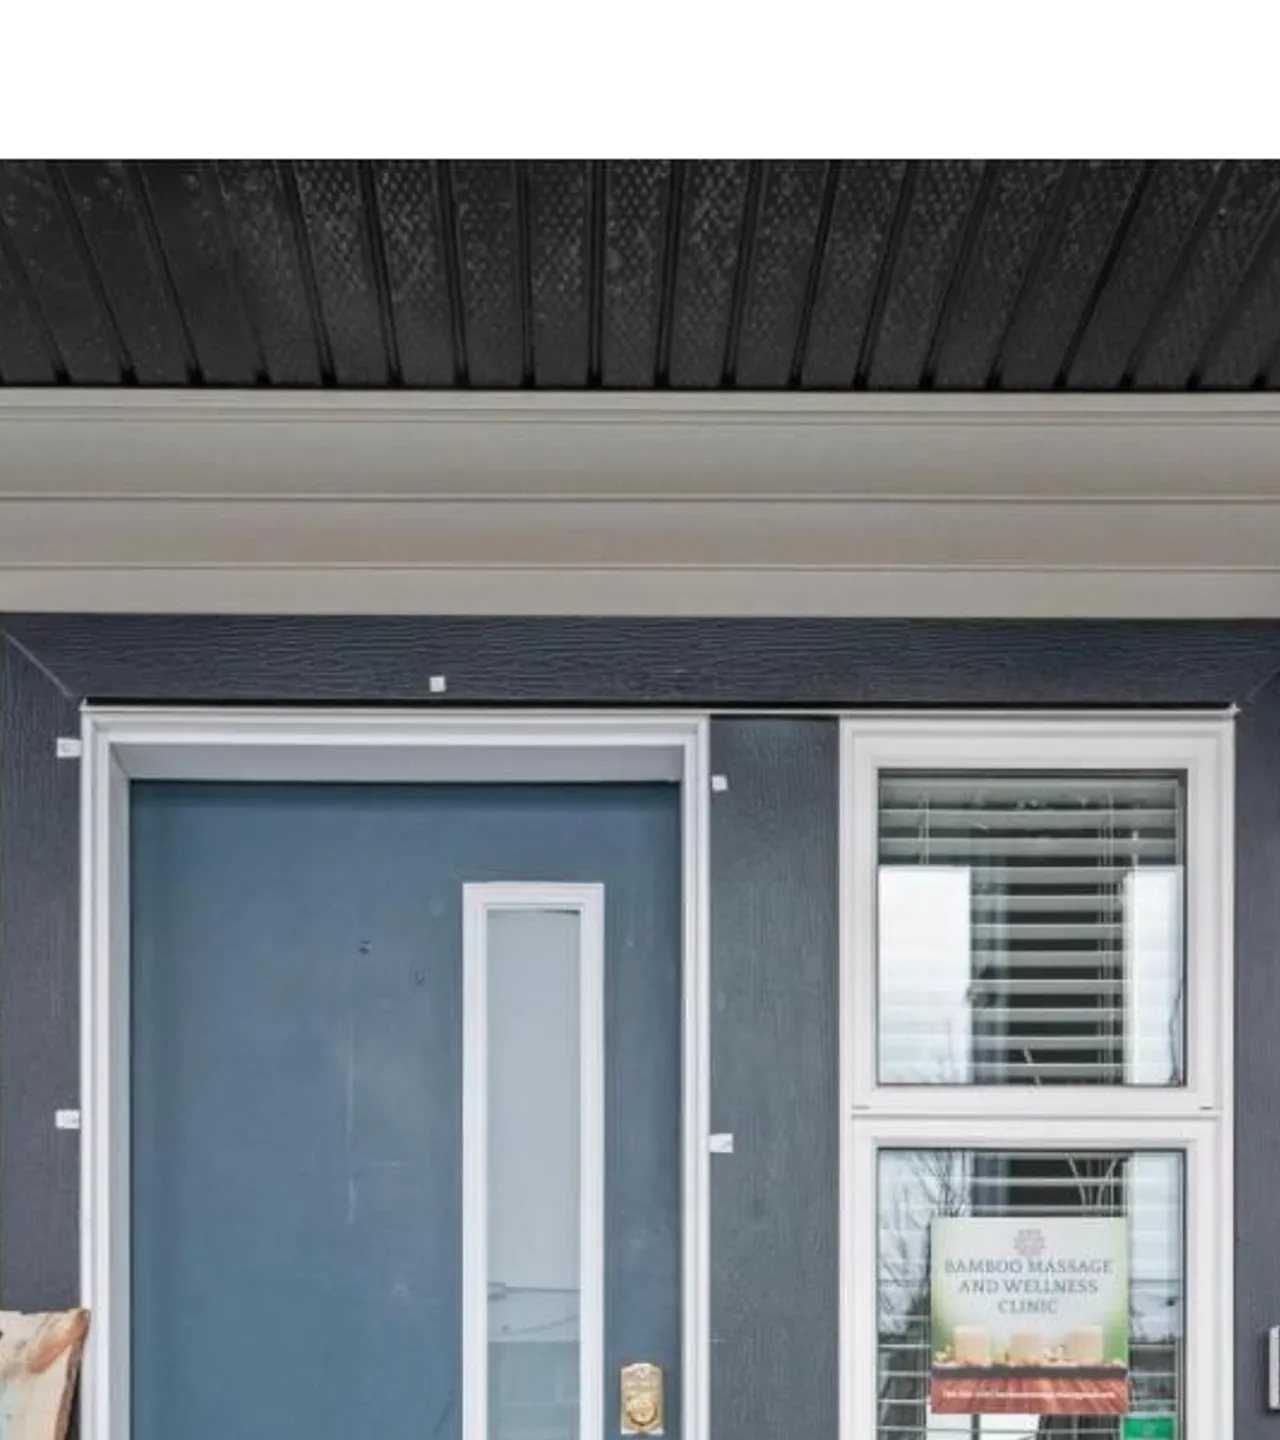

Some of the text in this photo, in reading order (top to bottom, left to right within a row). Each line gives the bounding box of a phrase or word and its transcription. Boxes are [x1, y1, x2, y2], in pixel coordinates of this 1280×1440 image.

[944, 1258, 1113, 1275] BAMBOO MASSAGE
[957, 1279, 1099, 1295] AND WELLNESS
[997, 1300, 1059, 1315] CLINIC
